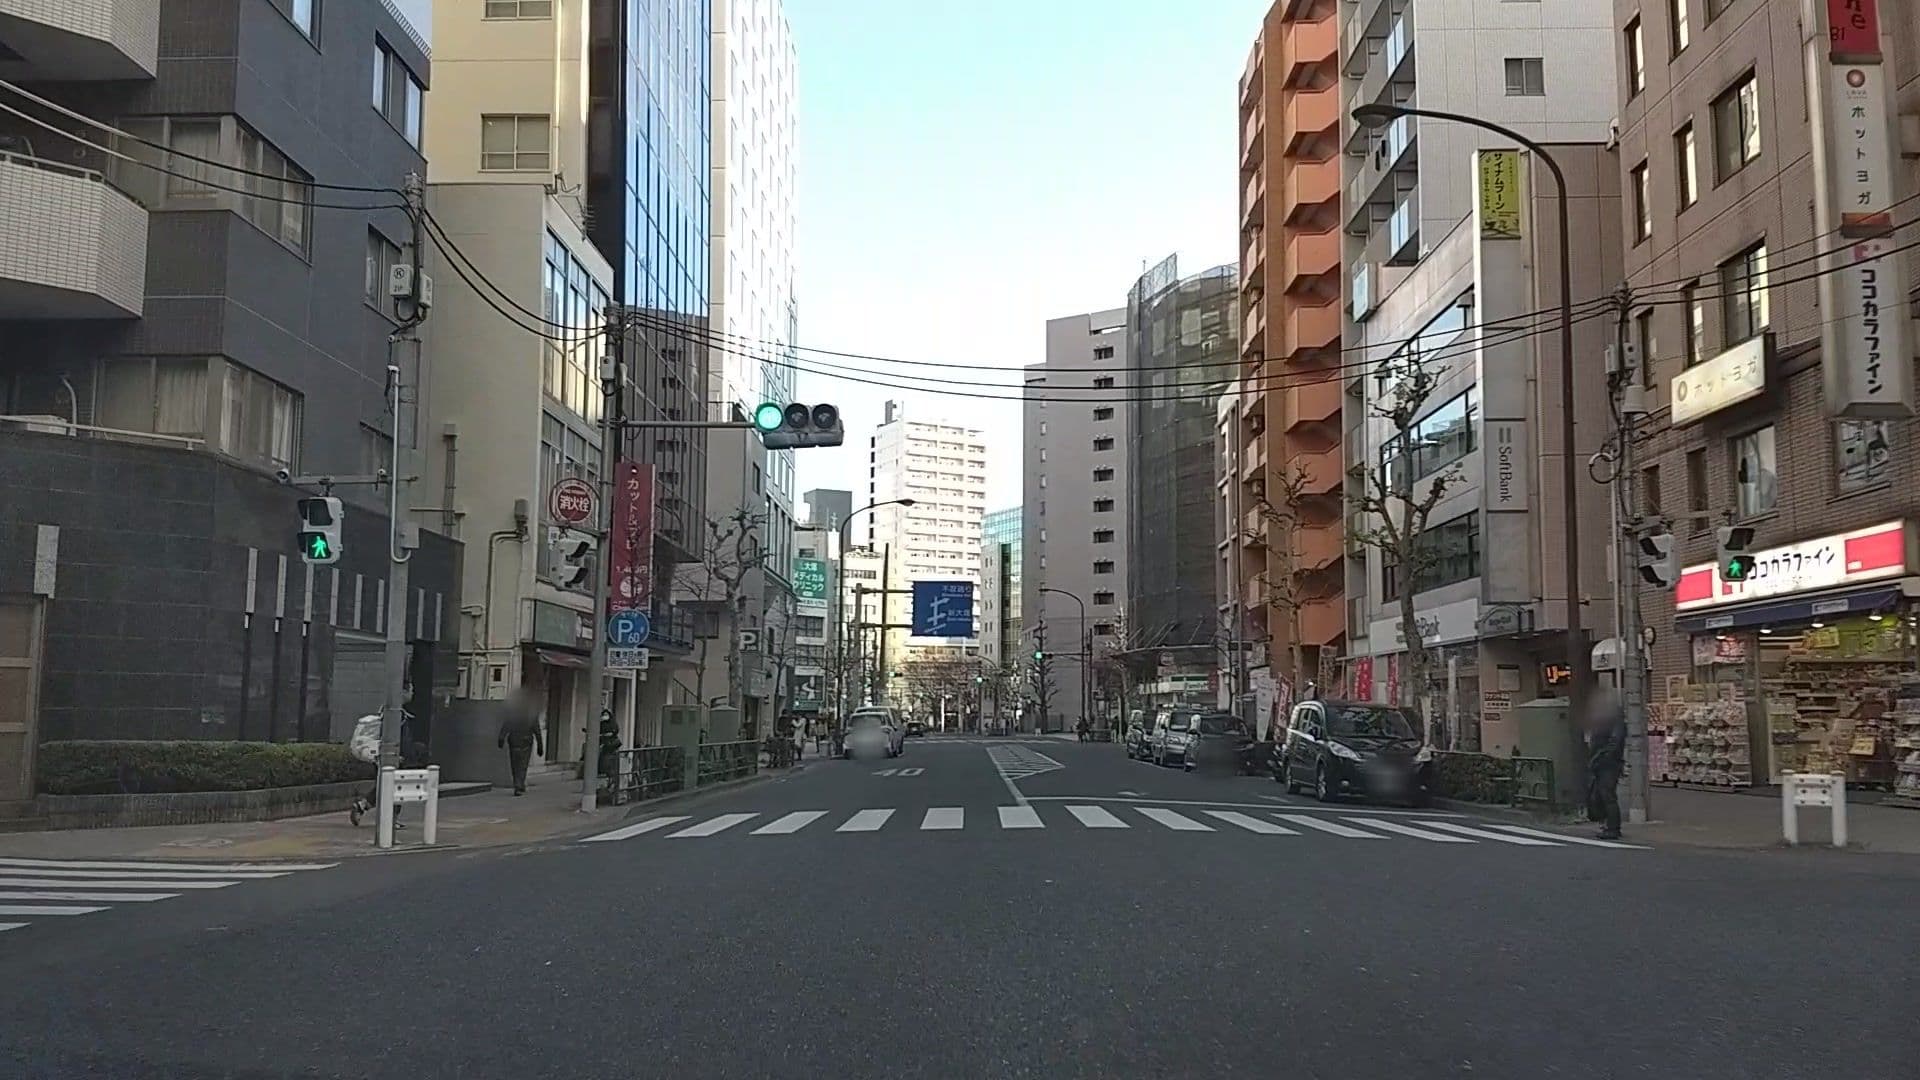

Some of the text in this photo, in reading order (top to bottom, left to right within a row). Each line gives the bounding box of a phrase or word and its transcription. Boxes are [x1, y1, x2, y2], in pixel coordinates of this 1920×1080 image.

[1851, 105, 1871, 205] ホットヨガ
[1861, 269, 1882, 394] ココカラファイン
[1499, 446, 1512, 502] SoftBank
[560, 495, 591, 513] 消火栓
[1749, 546, 1836, 580] ココカラファイン
[793, 571, 825, 583] メディカル
[793, 580, 825, 592] クリニック
[617, 620, 634, 643] P
[628, 632, 641, 643] 60
[740, 631, 757, 650] P
[872, 767, 926, 777] 40
